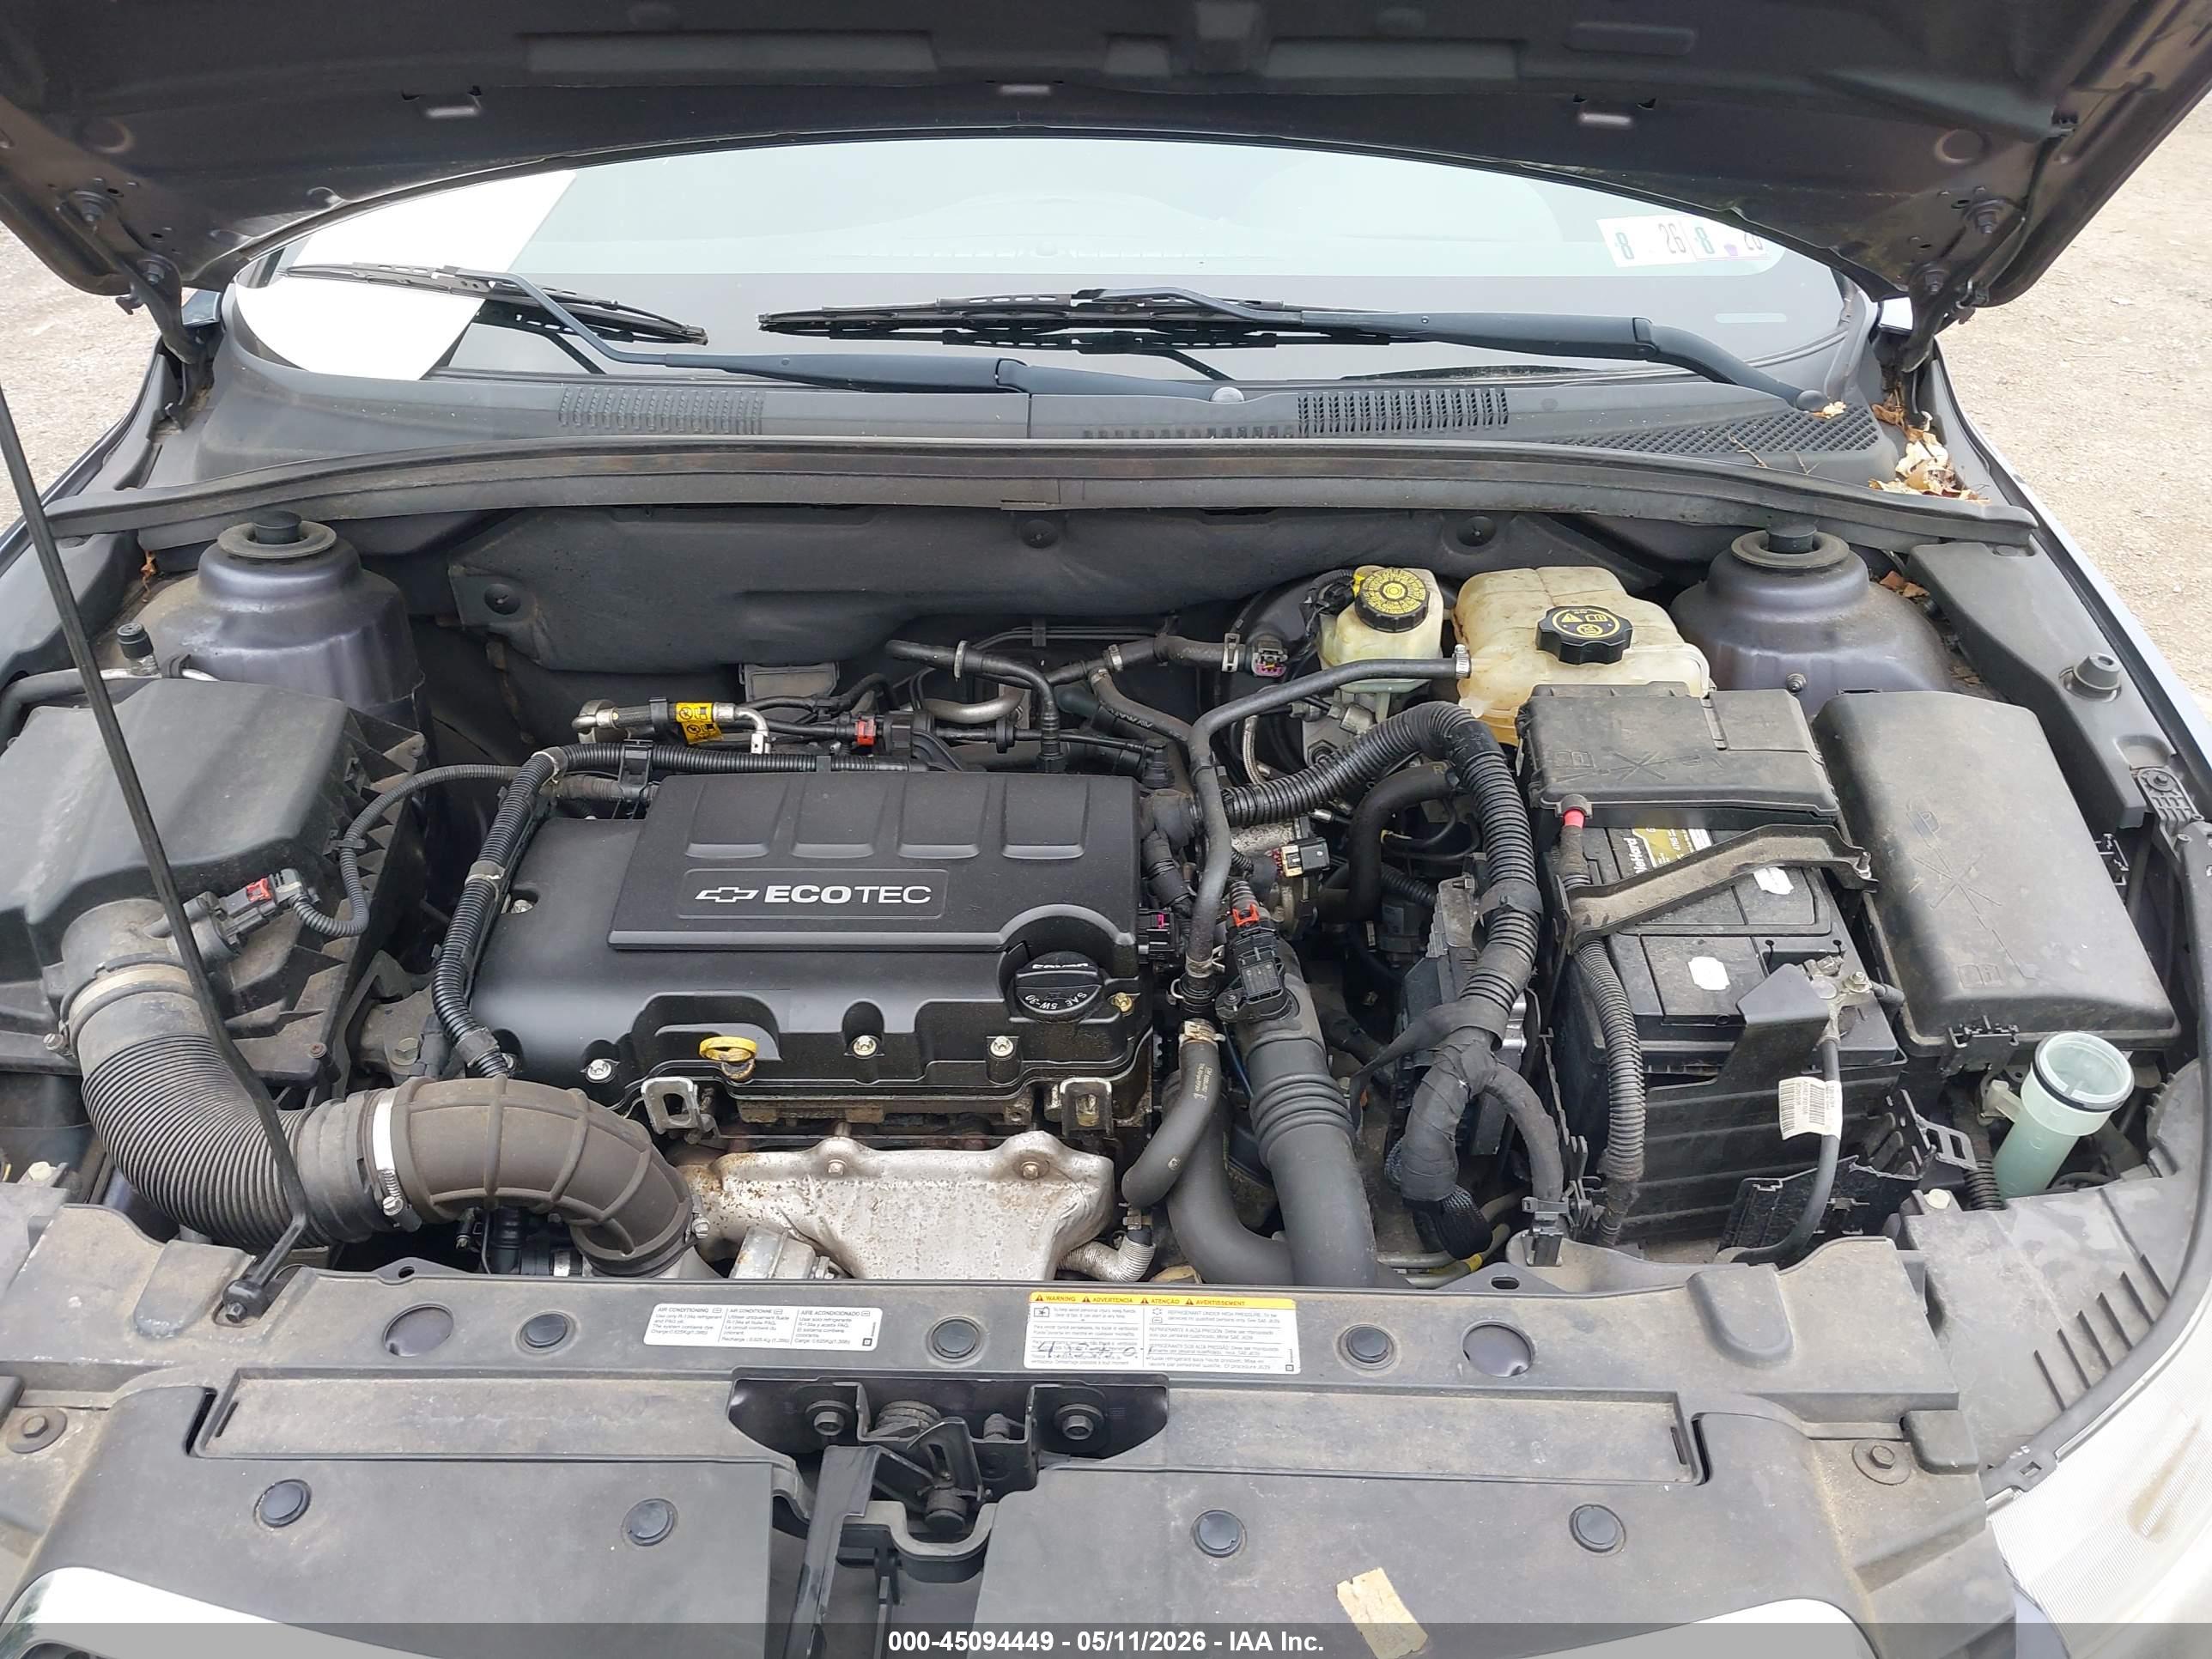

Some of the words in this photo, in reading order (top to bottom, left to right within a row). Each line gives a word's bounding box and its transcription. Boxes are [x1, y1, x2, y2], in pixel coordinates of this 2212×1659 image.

[1615, 231, 1635, 260] 8
[1657, 222, 1686, 254] 26
[1695, 227, 1716, 254] 8
[763, 884, 932, 904] ECOTEC
[1025, 994, 1059, 1010] 5W-30
[1065, 992, 1087, 1007] SAE
